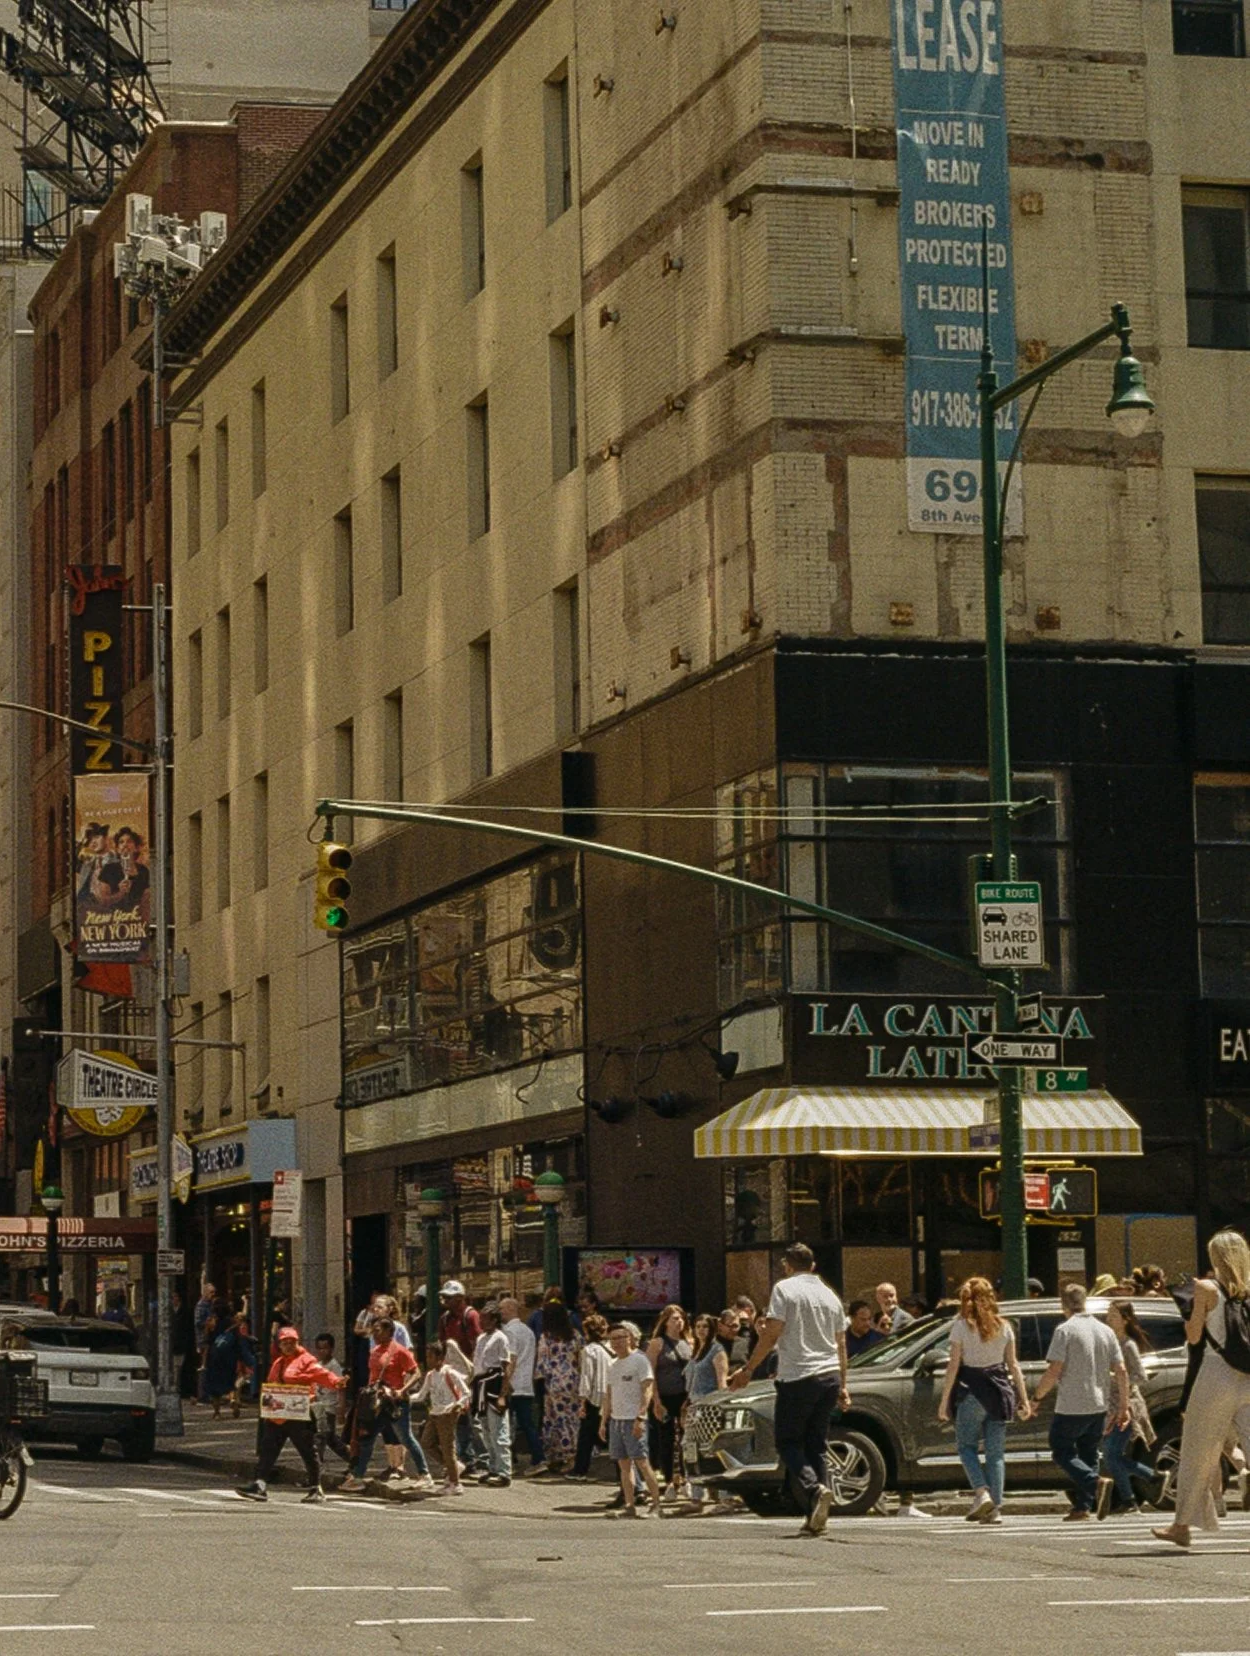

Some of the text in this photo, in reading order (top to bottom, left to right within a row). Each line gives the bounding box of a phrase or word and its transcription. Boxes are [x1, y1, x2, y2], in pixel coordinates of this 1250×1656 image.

[895, 0, 998, 75] LEASE
[914, 121, 984, 148] MOVE IN
[926, 158, 981, 186] READY
[915, 201, 996, 228] BROKERS
[906, 239, 1007, 268] PROTECTED
[918, 285, 999, 314] FLEXIBLE
[921, 509, 948, 522] 8th
[981, 888, 1035, 899] BIKE ROUTE
[81, 923, 146, 941] NEW YORK
[983, 930, 1037, 943] SHARED
[993, 947, 1029, 960] LANE
[809, 1004, 871, 1035] LA
[981, 1043, 1050, 1057] ONE WAY
[83, 1063, 157, 1099] THEATRE CIRCLE
[1046, 1072, 1079, 1090] 8 AV
[57, 1236, 125, 1248] IZZERIA
